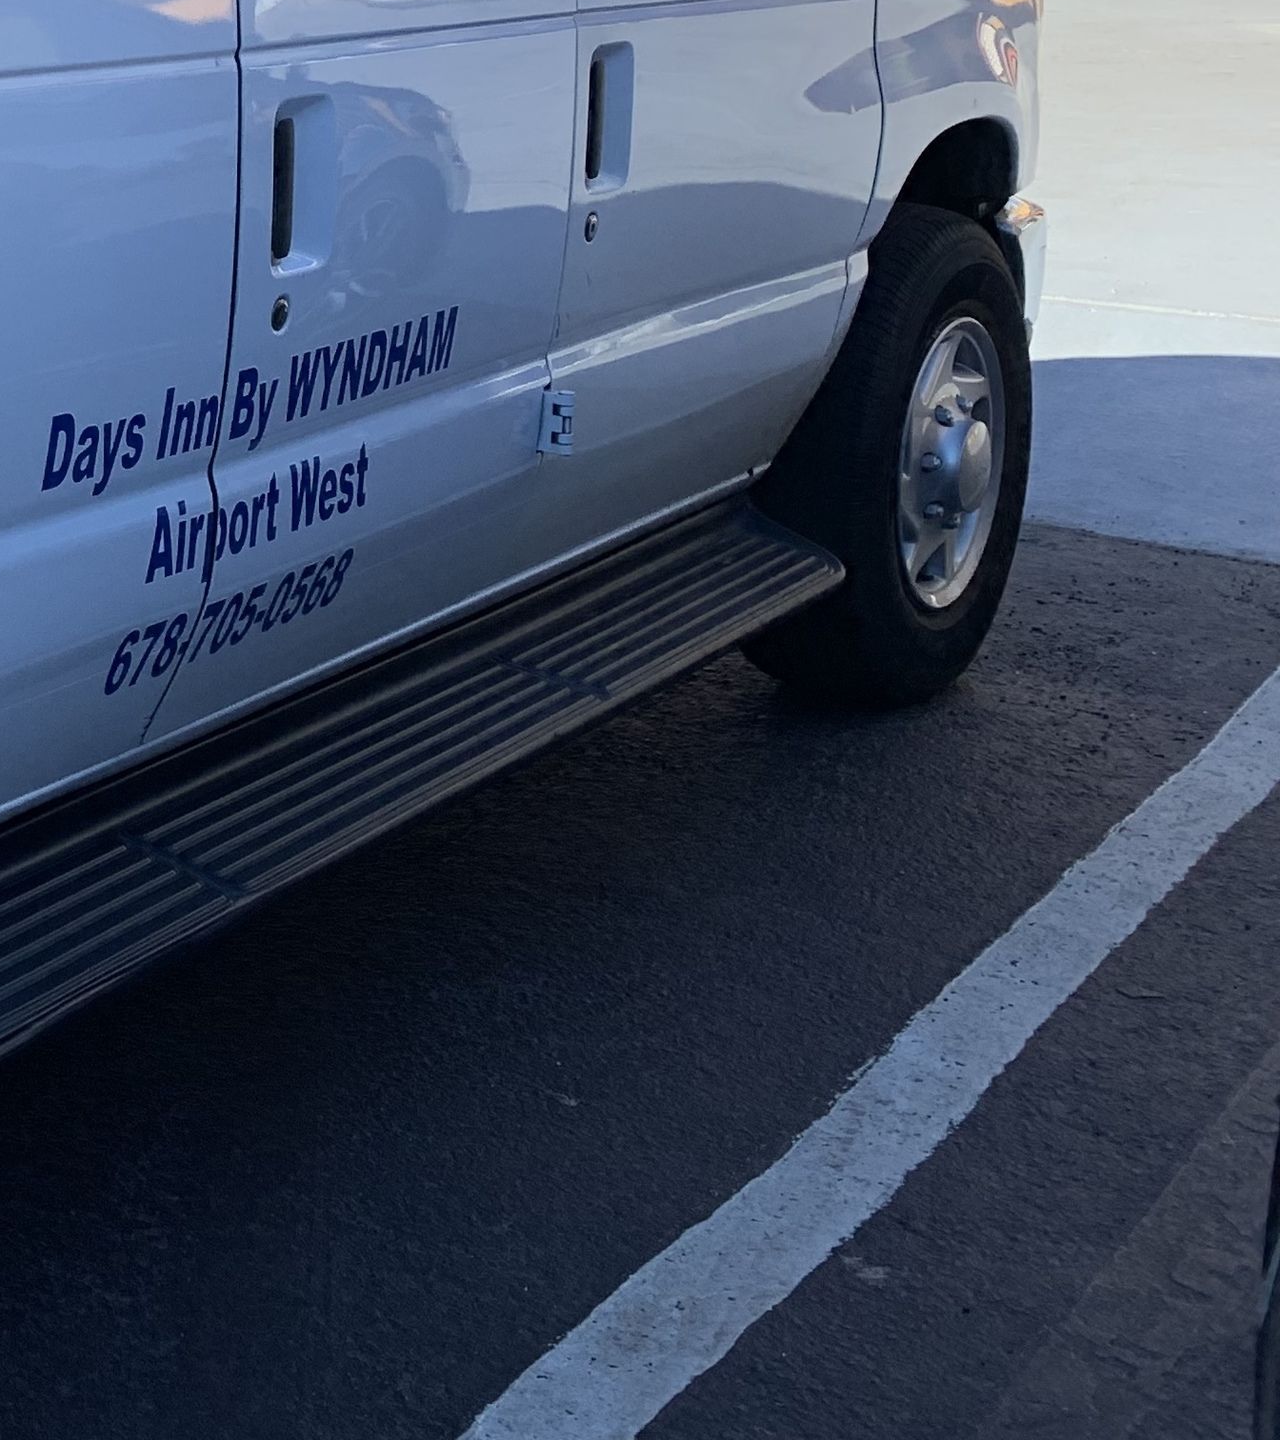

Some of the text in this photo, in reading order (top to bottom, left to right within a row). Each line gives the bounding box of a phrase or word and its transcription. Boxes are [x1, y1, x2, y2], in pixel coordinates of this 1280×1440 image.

[40, 306, 459, 497] Days Inn By WYNDHAM
[144, 442, 369, 584] Airport West
[103, 547, 355, 696] 678-705-0568
